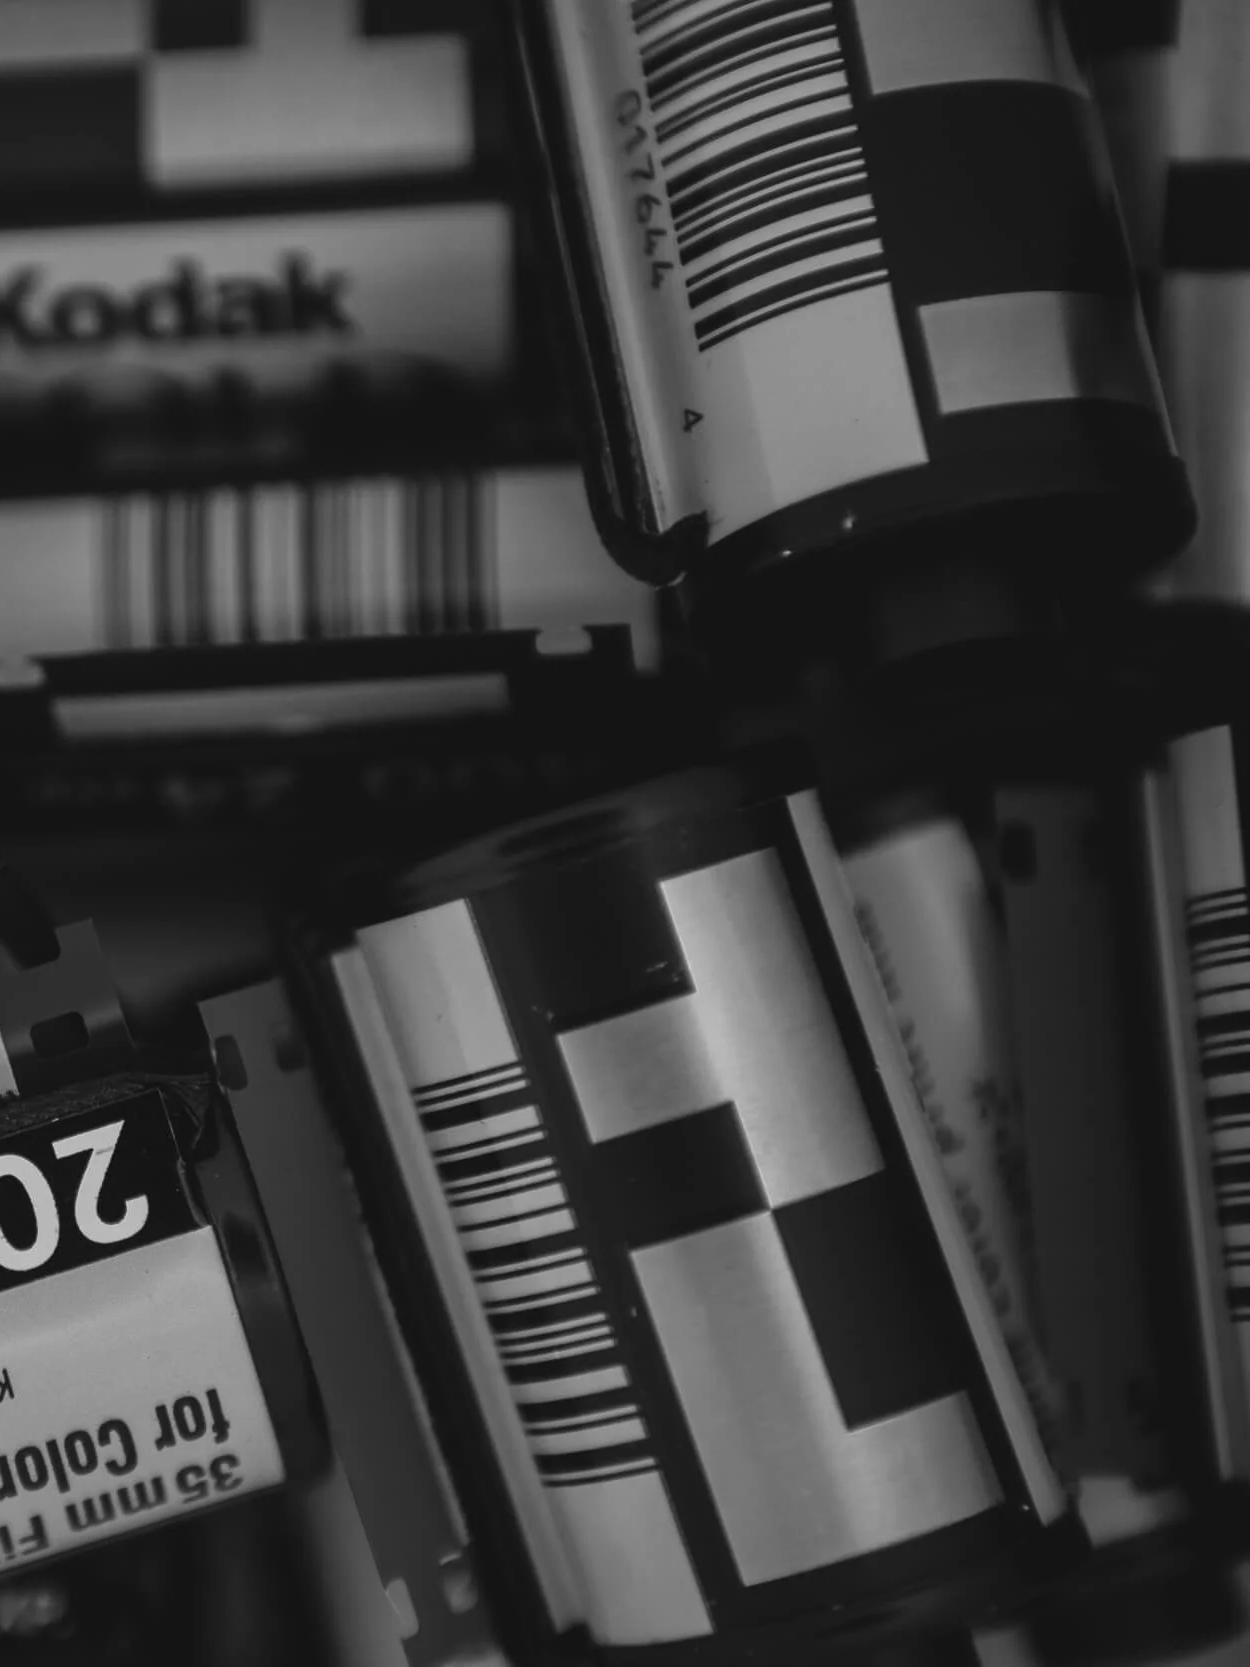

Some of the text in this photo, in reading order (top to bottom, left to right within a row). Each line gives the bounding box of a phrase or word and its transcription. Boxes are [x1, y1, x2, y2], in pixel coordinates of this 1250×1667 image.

[683, 409, 703, 433] 4
[155, 1388, 231, 1448] for
[176, 1453, 244, 1493] 35
